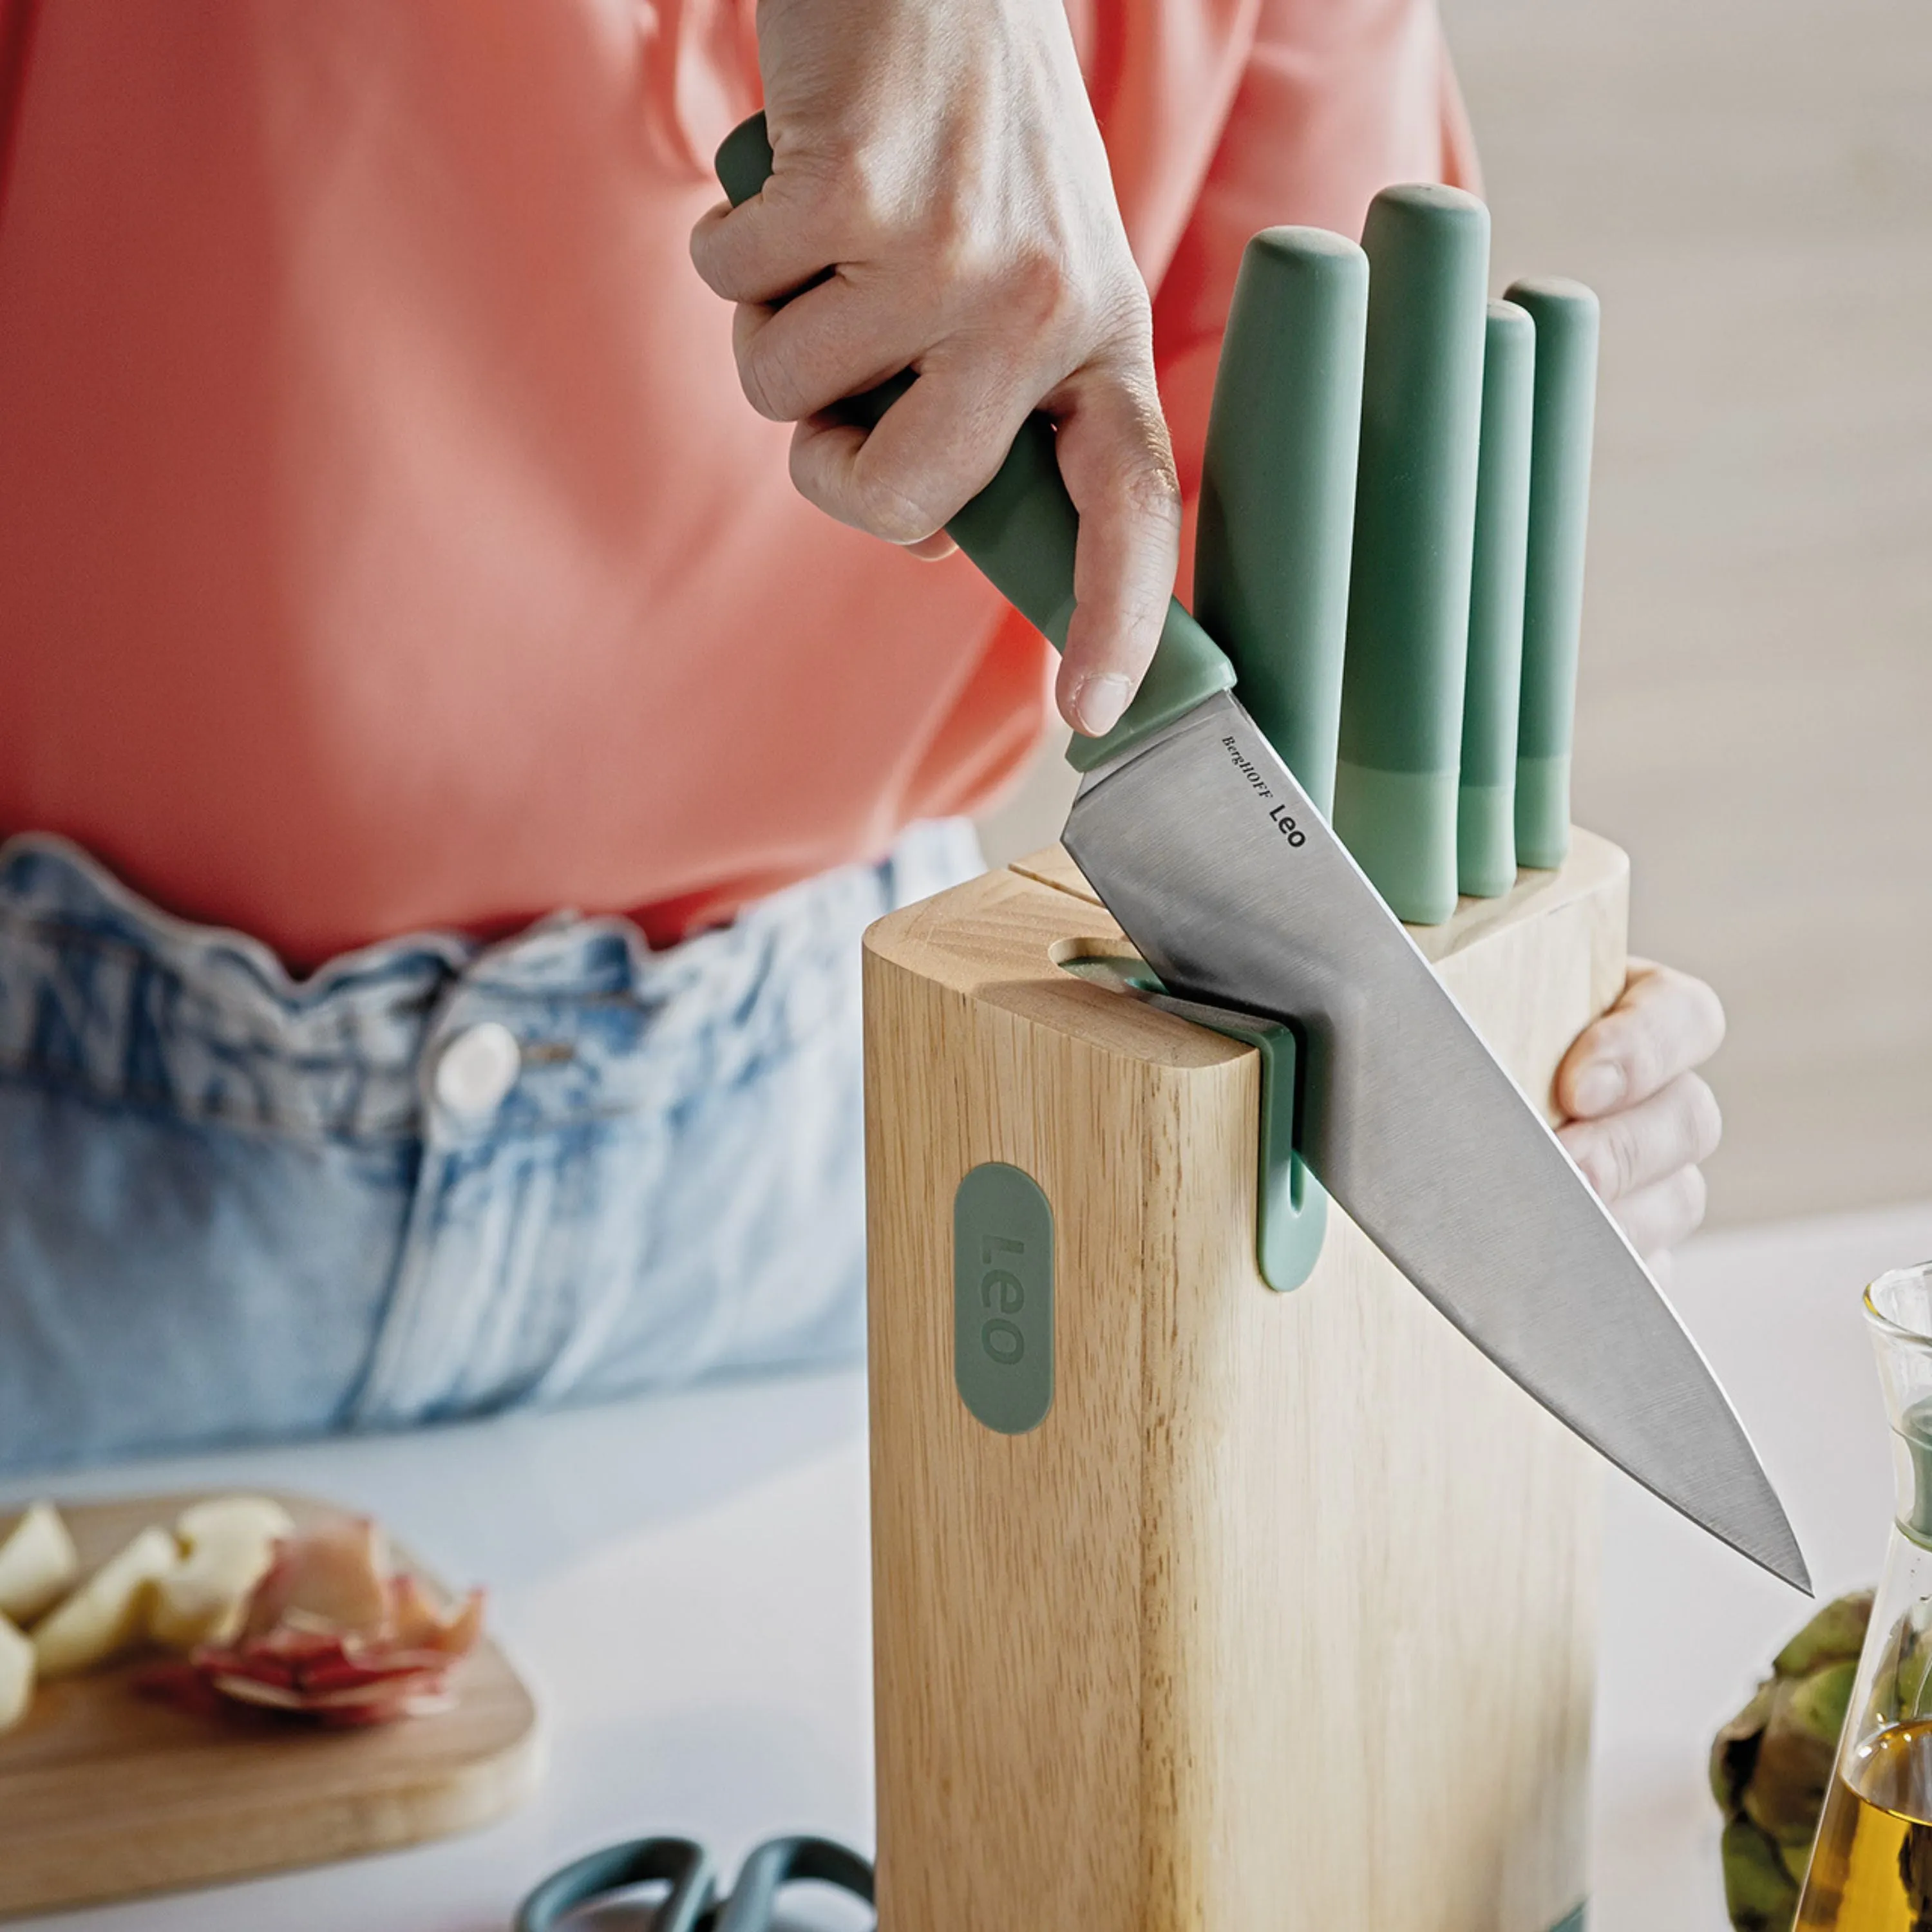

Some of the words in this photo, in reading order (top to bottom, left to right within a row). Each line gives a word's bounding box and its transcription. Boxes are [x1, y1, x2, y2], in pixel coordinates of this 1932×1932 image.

[1222, 736, 1273, 799] BergHOFF
[1269, 804, 1306, 848] Leo
[981, 1234, 1025, 1365] Leo
